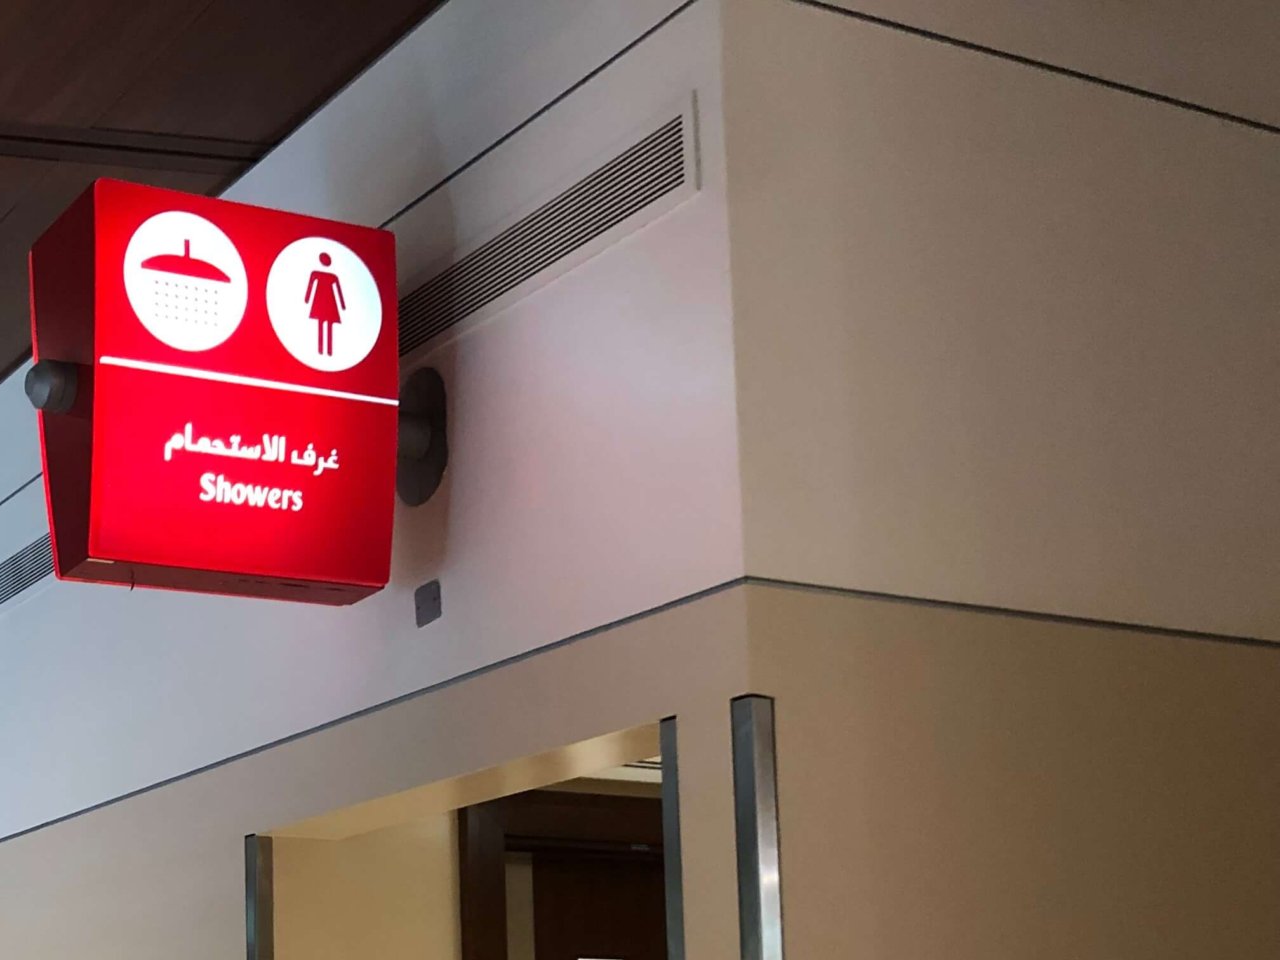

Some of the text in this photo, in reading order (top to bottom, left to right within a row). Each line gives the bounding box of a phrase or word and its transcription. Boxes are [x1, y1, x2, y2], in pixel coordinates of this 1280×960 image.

[164, 422, 339, 476] غرف الاستحمام
[199, 472, 303, 512] Showers
